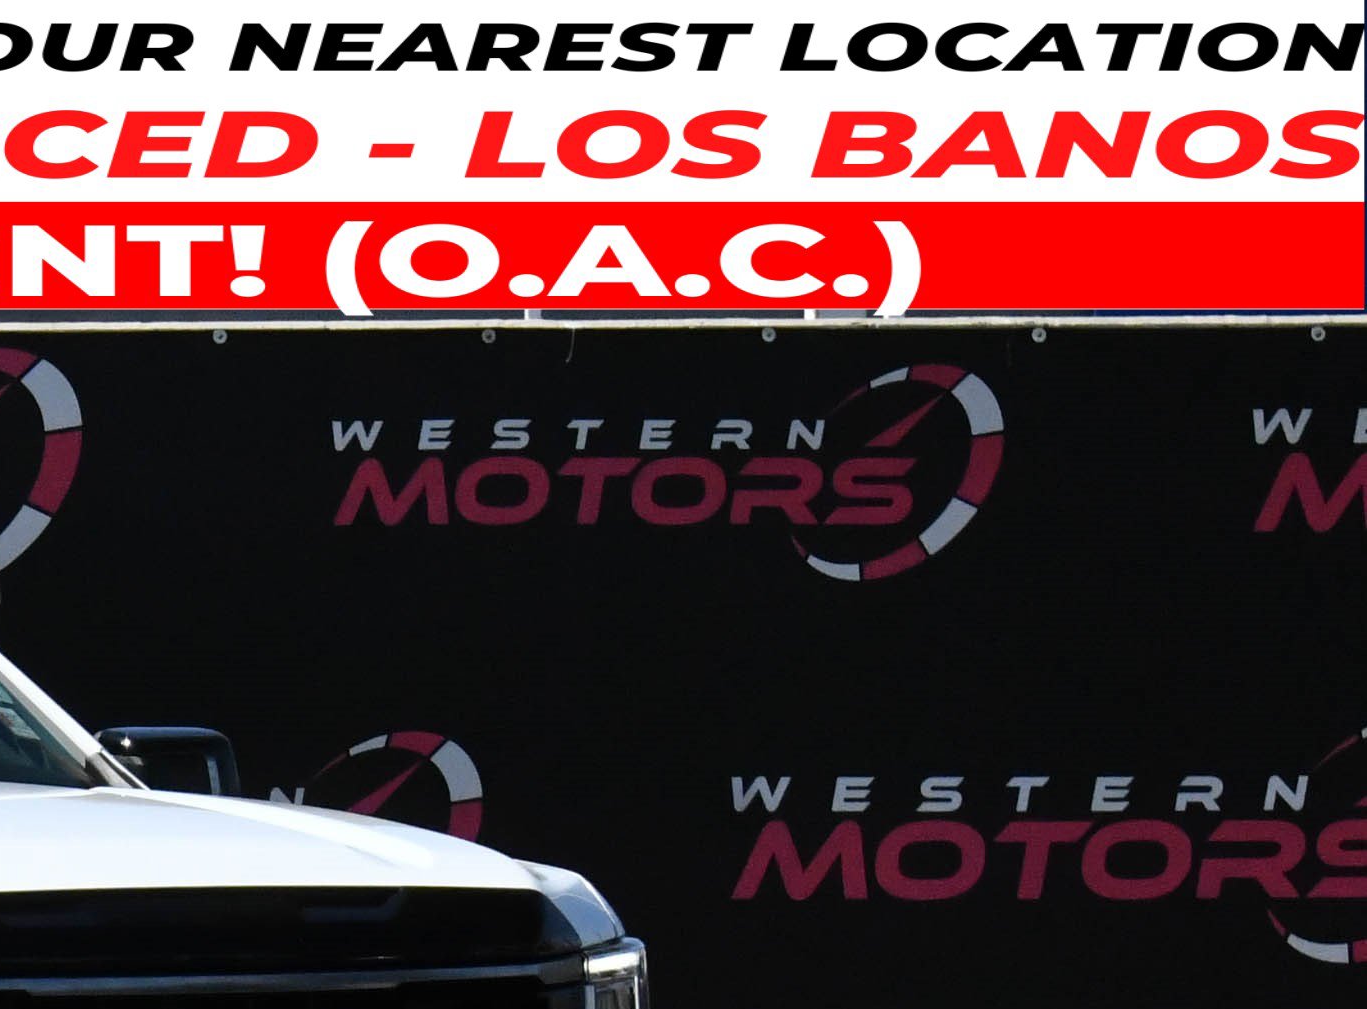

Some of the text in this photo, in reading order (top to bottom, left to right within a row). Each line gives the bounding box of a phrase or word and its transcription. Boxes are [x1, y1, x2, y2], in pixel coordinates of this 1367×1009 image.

[332, 419, 825, 452] WESTERN
[334, 456, 915, 527] MOTORS
[731, 775, 1309, 812] WESTERN
